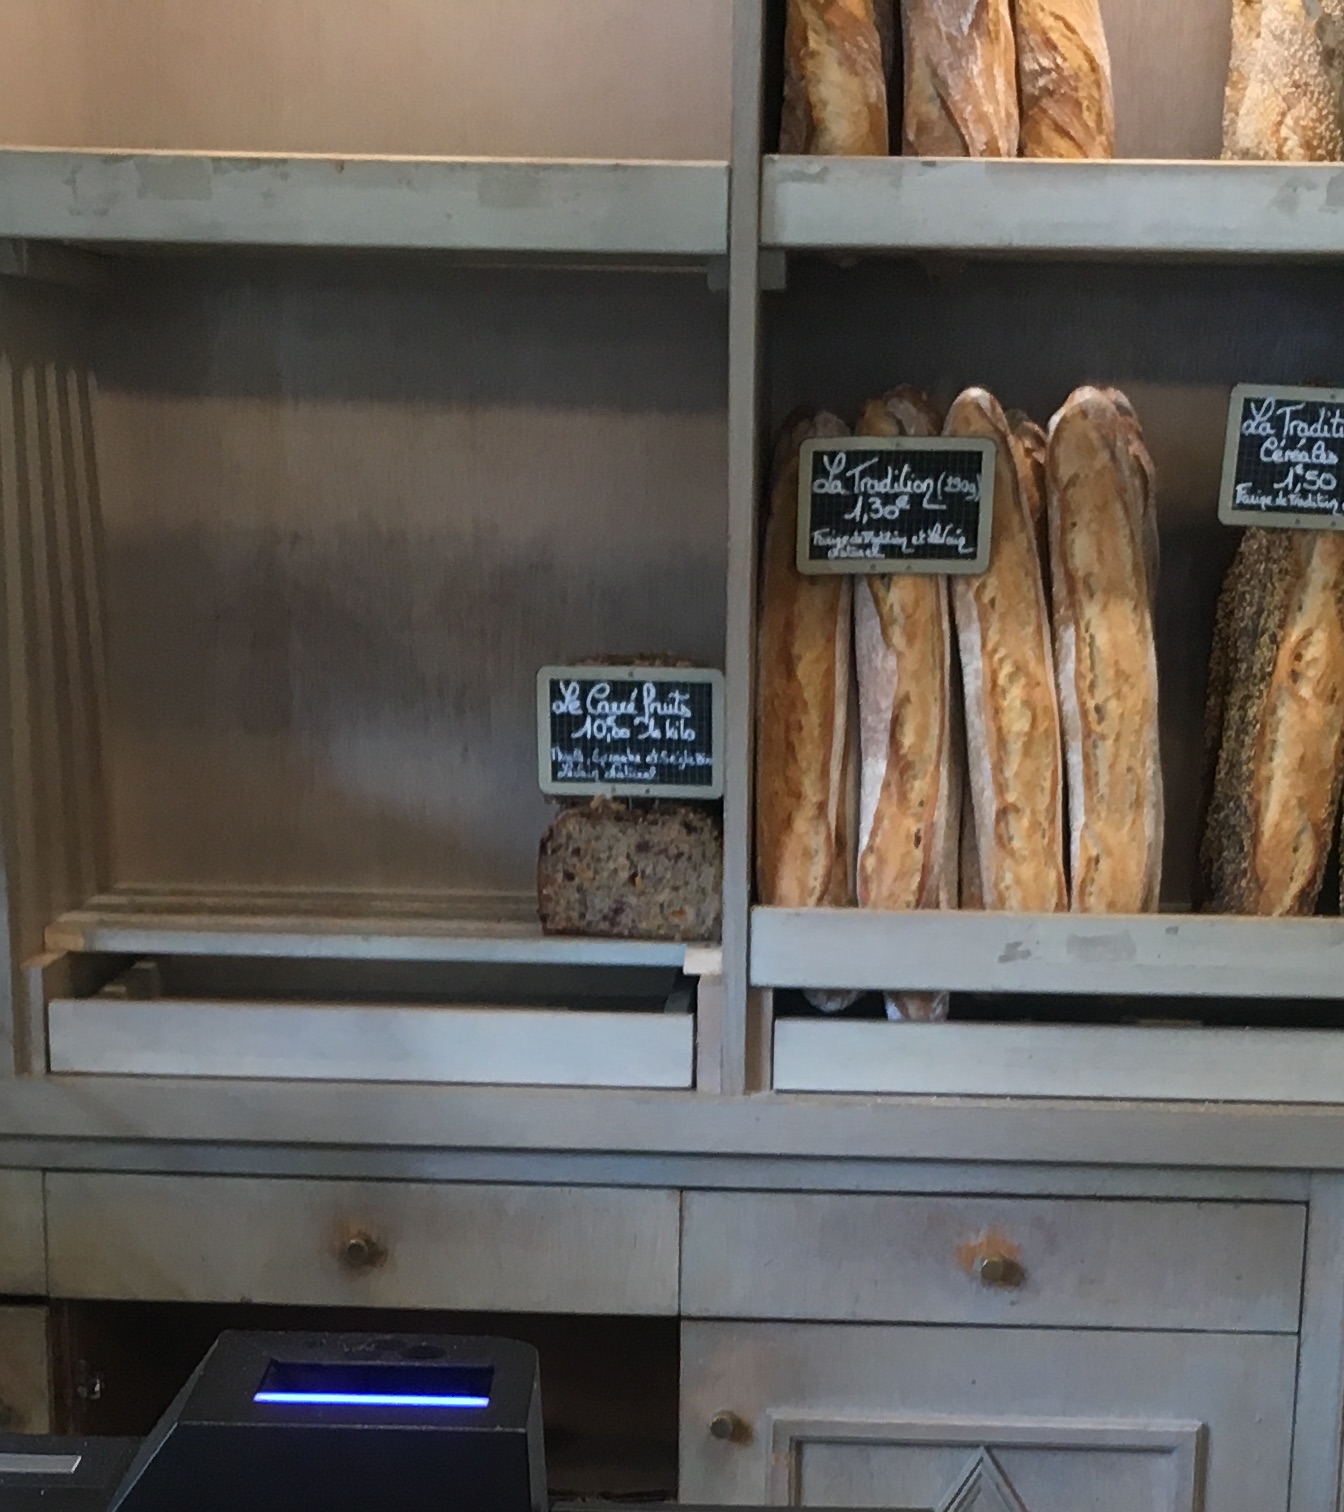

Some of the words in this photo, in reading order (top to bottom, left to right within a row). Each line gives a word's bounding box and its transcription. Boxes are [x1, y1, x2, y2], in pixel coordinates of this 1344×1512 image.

[1260, 437, 1338, 464] Céréales
[846, 457, 946, 510] Tradition
[665, 716, 696, 741] kilo
